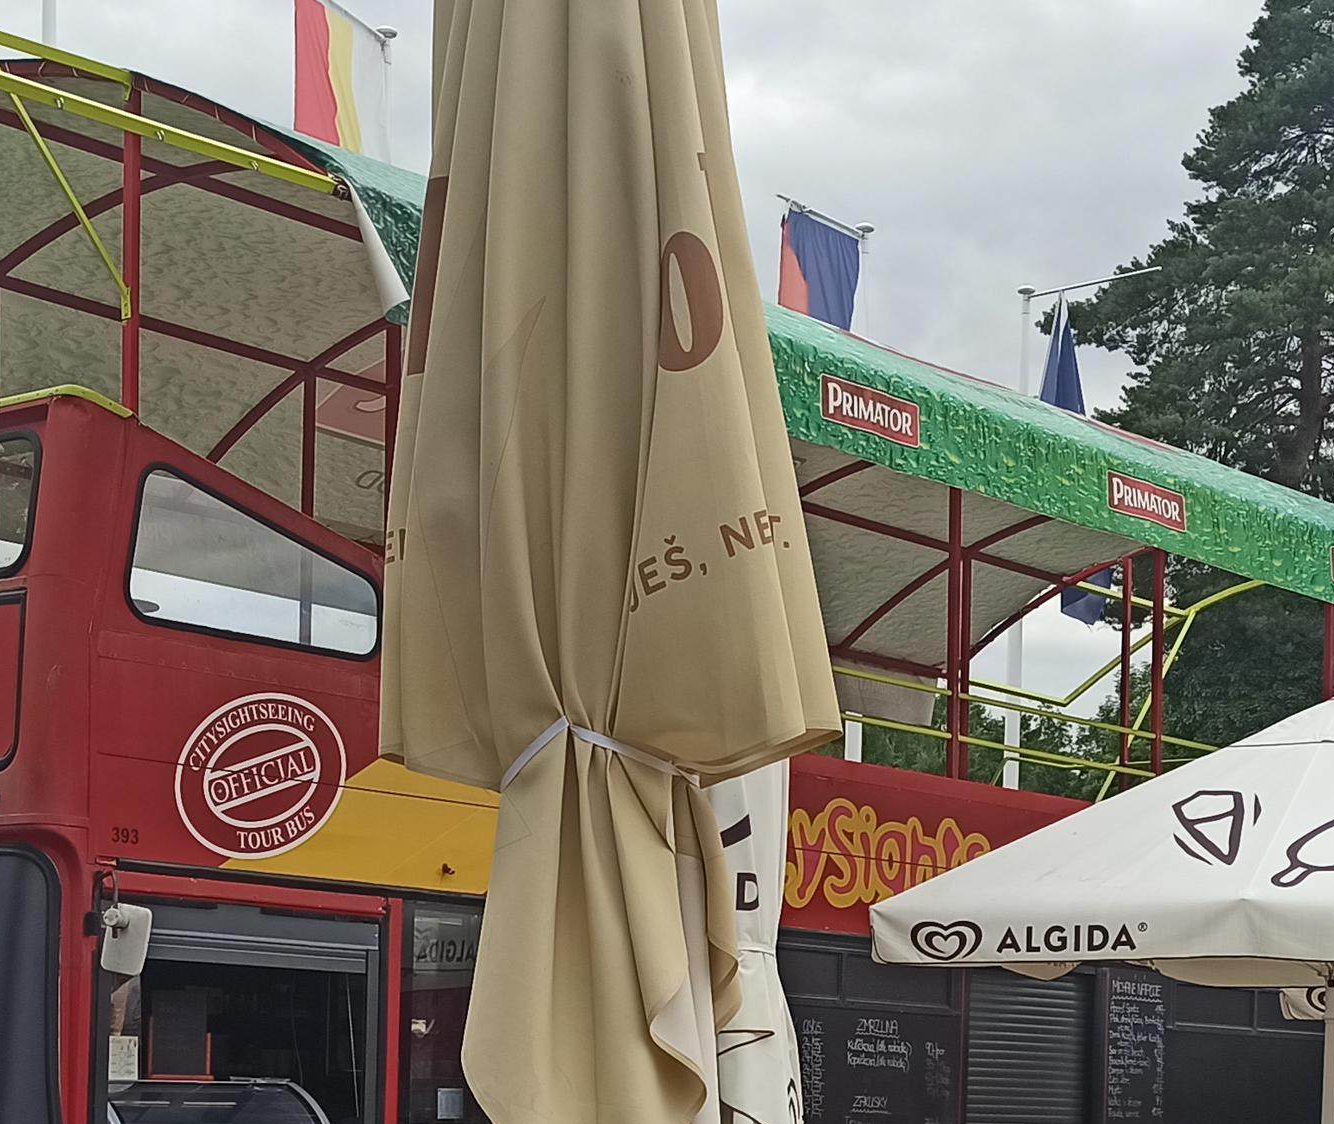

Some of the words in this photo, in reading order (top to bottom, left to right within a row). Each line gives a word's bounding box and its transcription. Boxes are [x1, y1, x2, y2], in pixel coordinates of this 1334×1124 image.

[827, 382, 914, 438] PRIMATOR
[1112, 477, 1181, 523] PRIMATOR
[189, 703, 315, 771] CITYSIGHTSEEING
[210, 751, 314, 803] OFFICIAL
[111, 828, 139, 845] 393
[237, 827, 285, 849] TOUR
[285, 806, 315, 840] BUS
